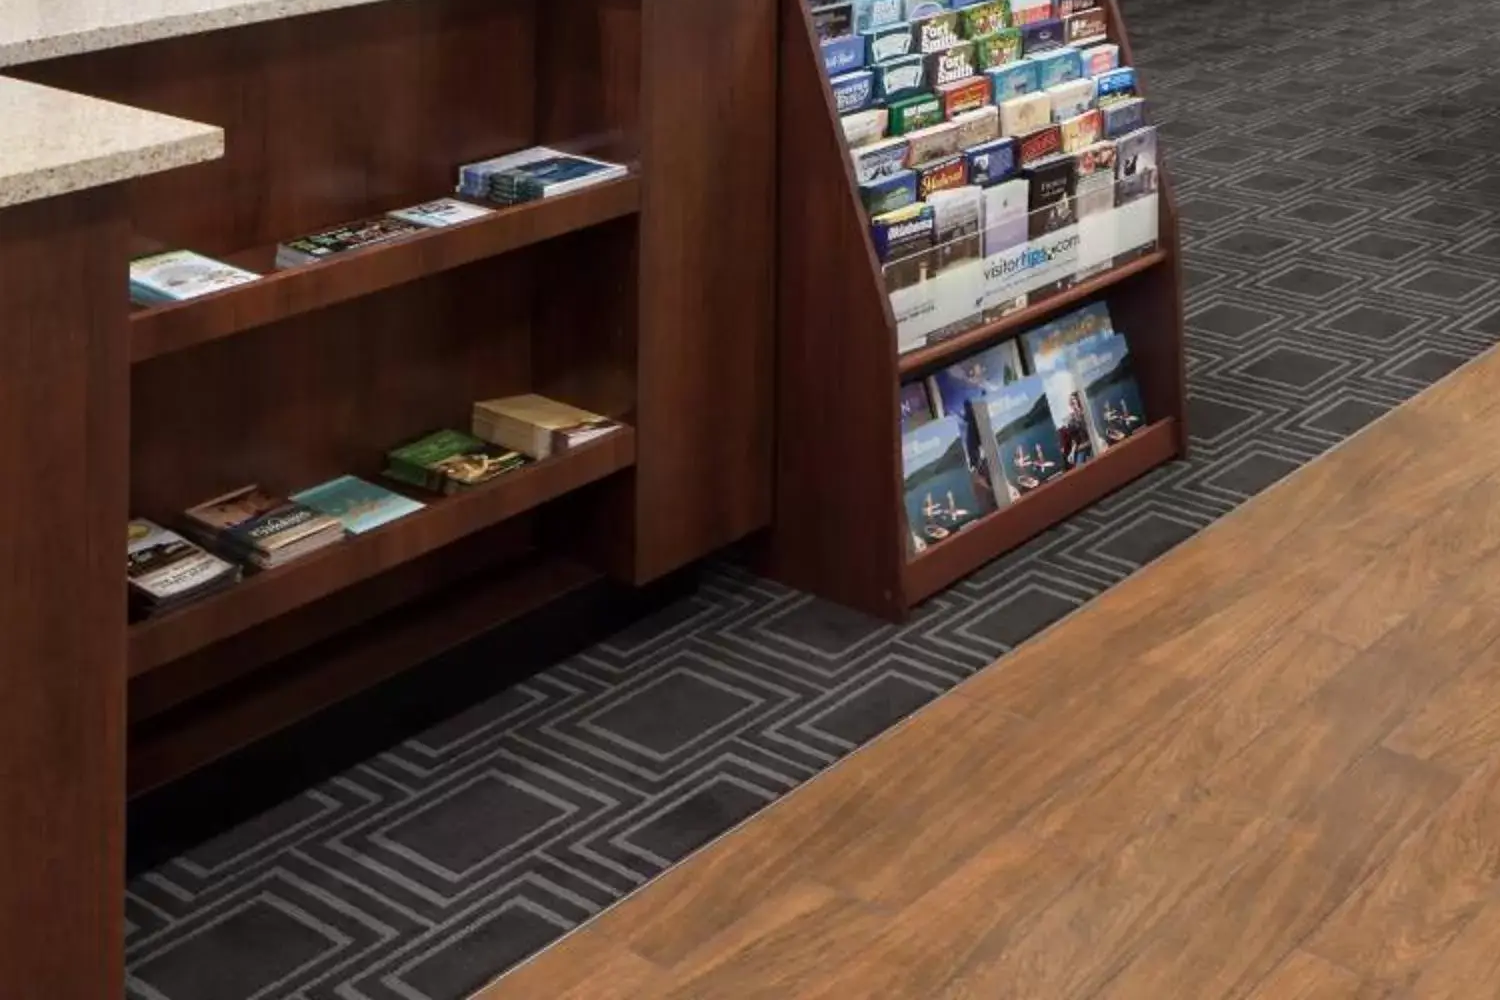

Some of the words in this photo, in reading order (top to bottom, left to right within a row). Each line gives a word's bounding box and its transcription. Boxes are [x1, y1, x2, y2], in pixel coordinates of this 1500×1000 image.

[921, 20, 949, 39] Fort
[921, 33, 960, 54] Smith
[937, 52, 965, 71] Fort
[937, 64, 975, 85] Smith
